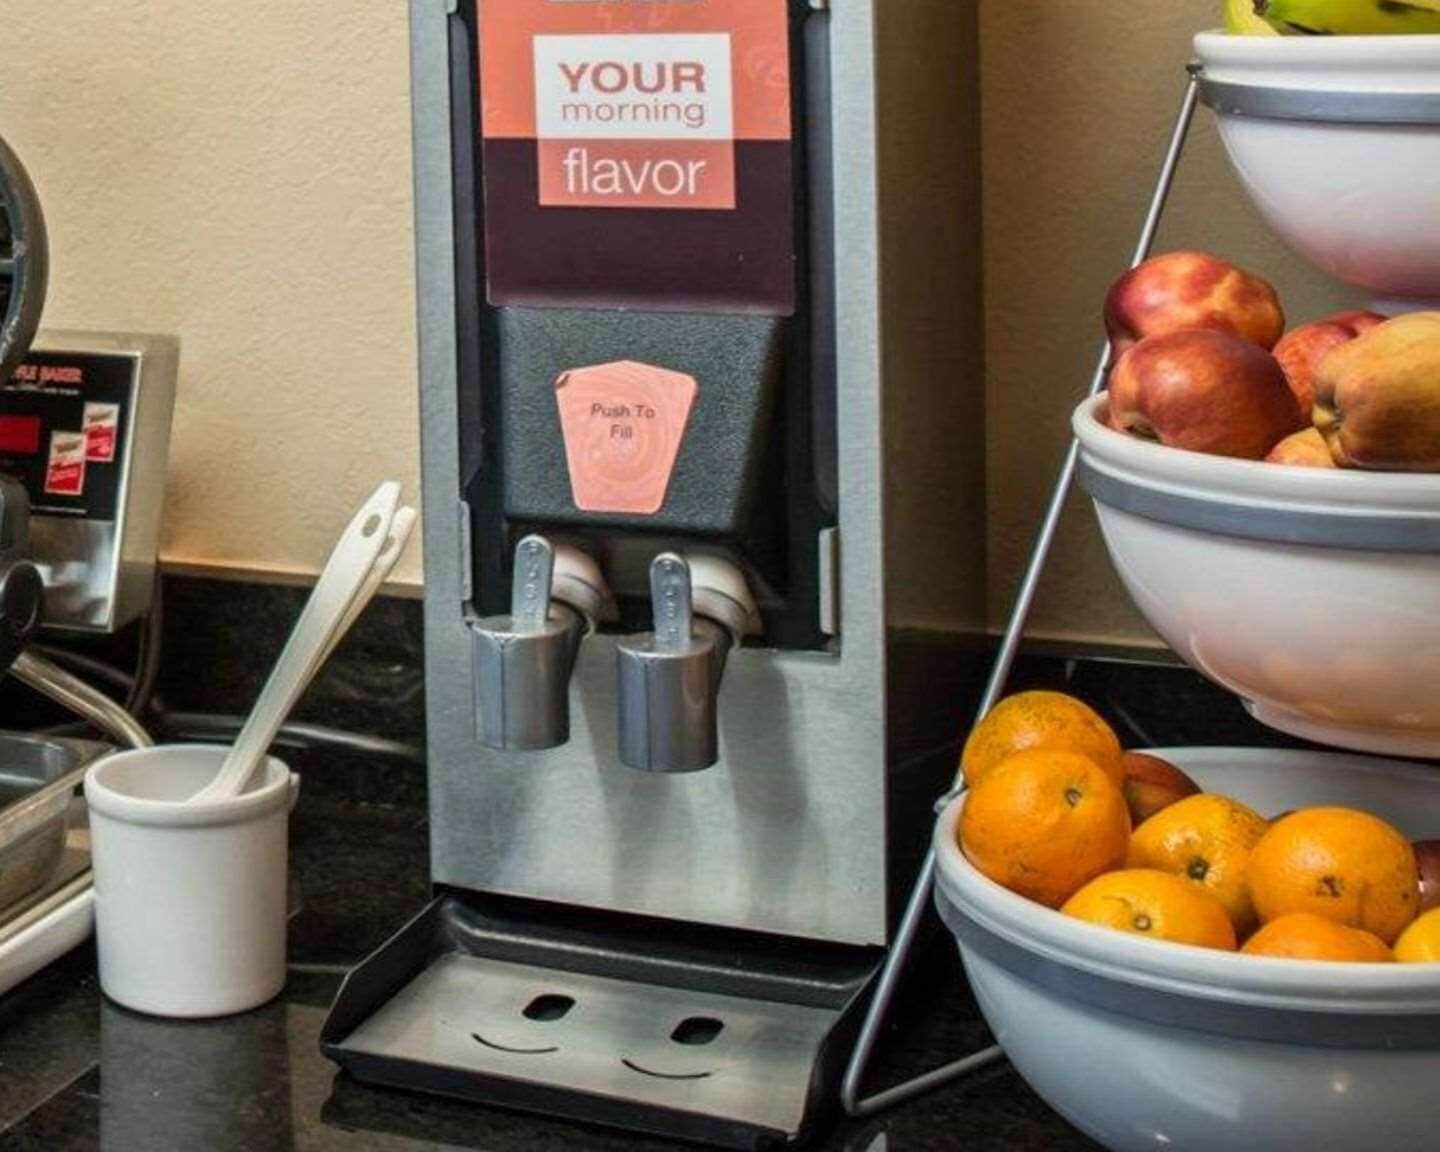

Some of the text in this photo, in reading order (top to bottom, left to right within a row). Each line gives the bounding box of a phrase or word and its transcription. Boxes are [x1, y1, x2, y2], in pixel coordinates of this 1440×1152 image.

[558, 61, 706, 93] YOUR
[562, 98, 705, 129] morning
[563, 147, 707, 195] flavor
[591, 403, 656, 419] Push To
[610, 424, 633, 439] Fill
